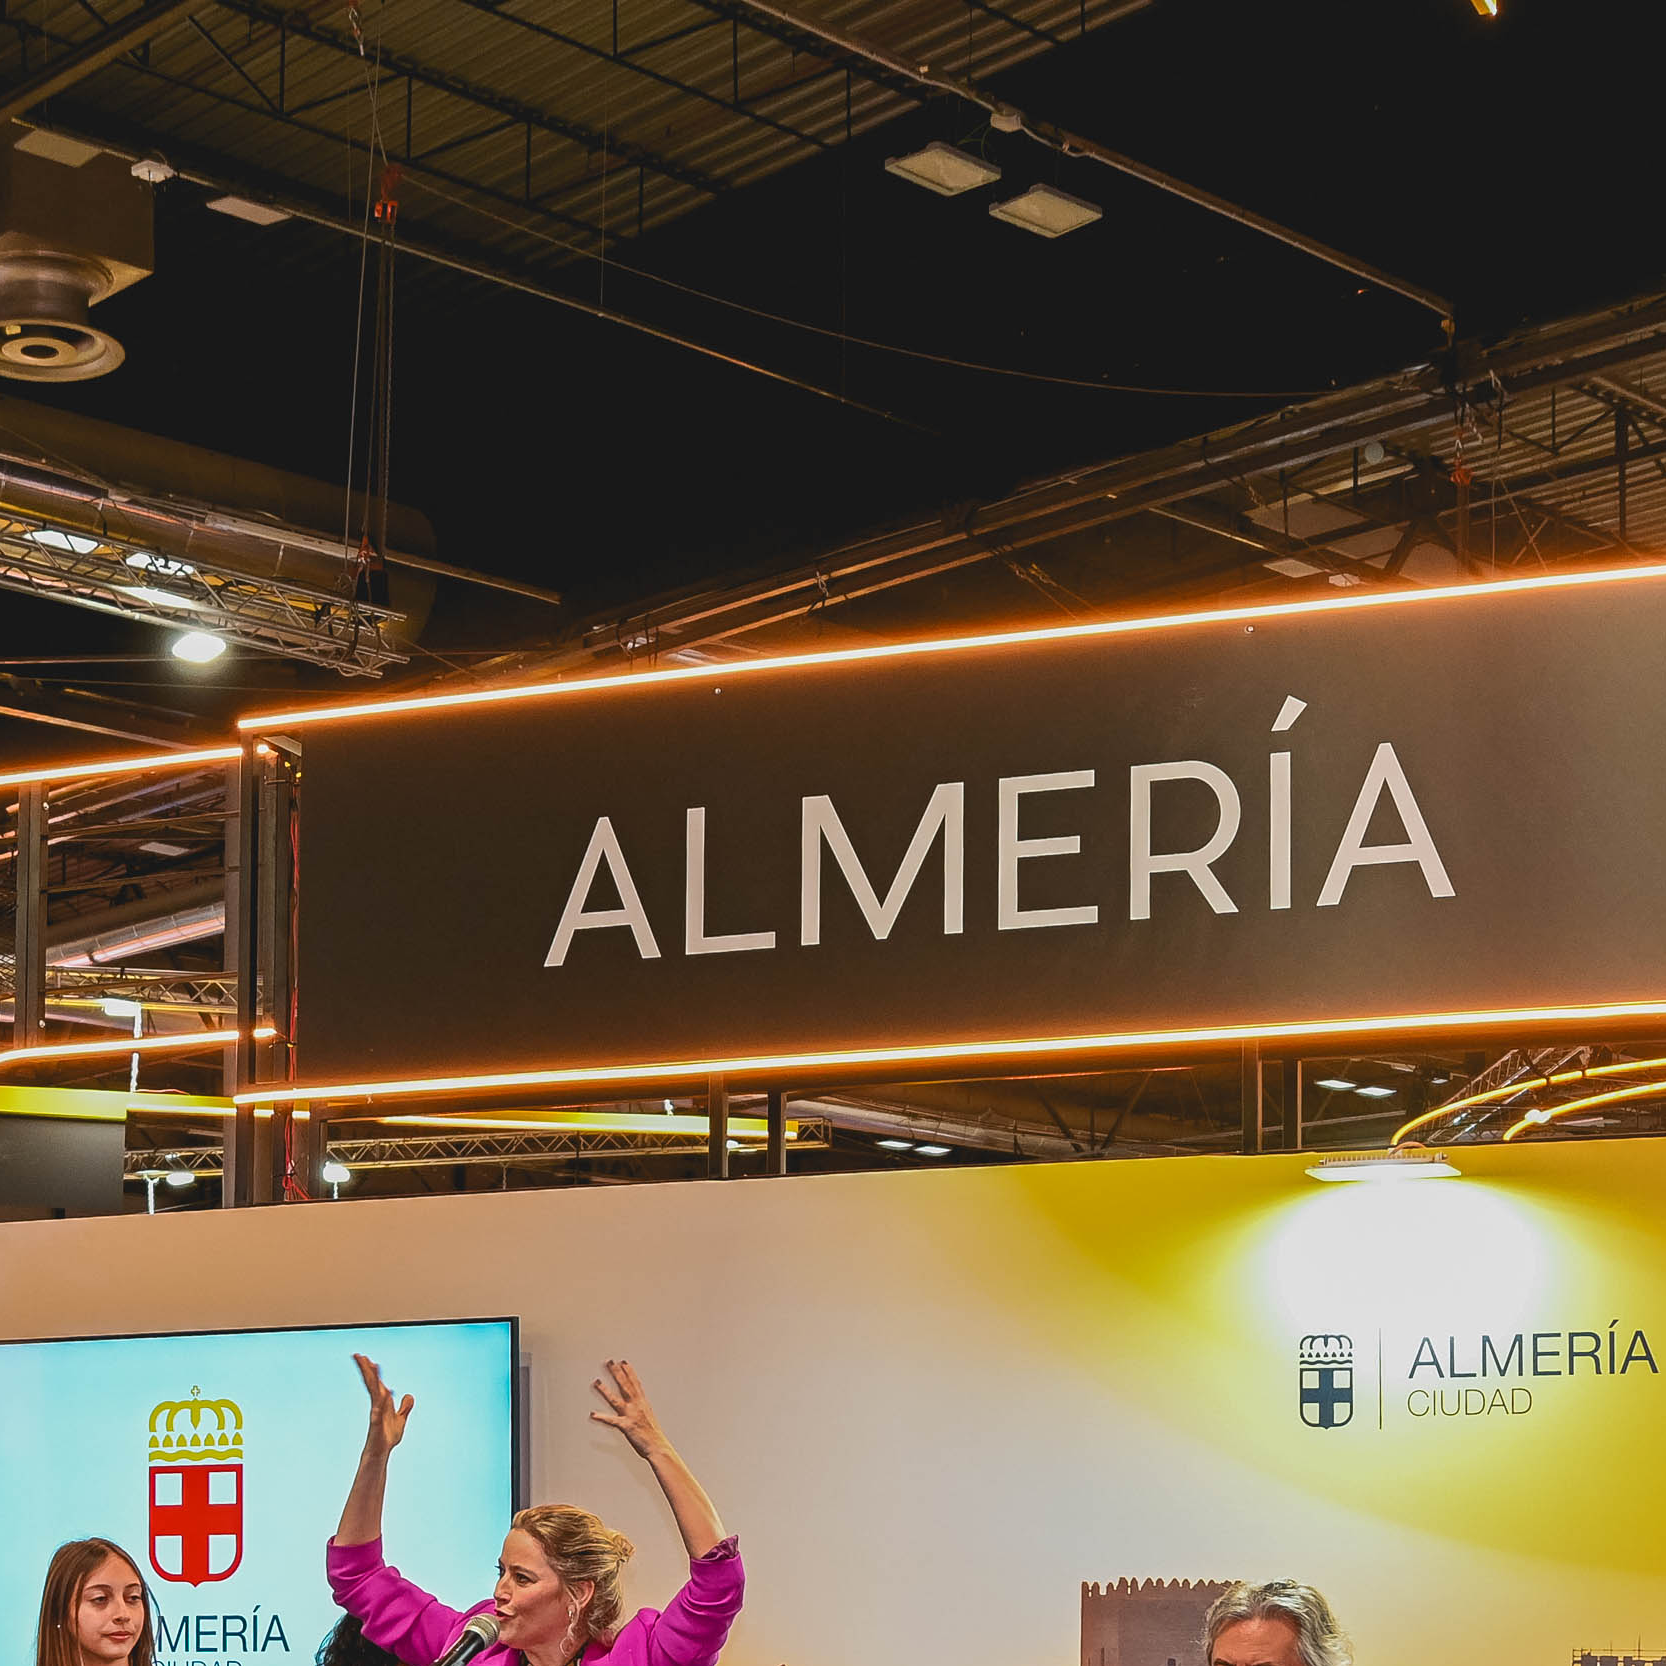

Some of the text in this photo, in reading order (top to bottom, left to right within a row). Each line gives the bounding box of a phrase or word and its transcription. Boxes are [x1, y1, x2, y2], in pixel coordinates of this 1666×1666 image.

[543, 695, 1456, 968] ALMERÍA
[1408, 1319, 1659, 1380] ALMERÍA
[1407, 1386, 1534, 1418] CIUDAD
[157, 1604, 291, 1652] MERÍA
